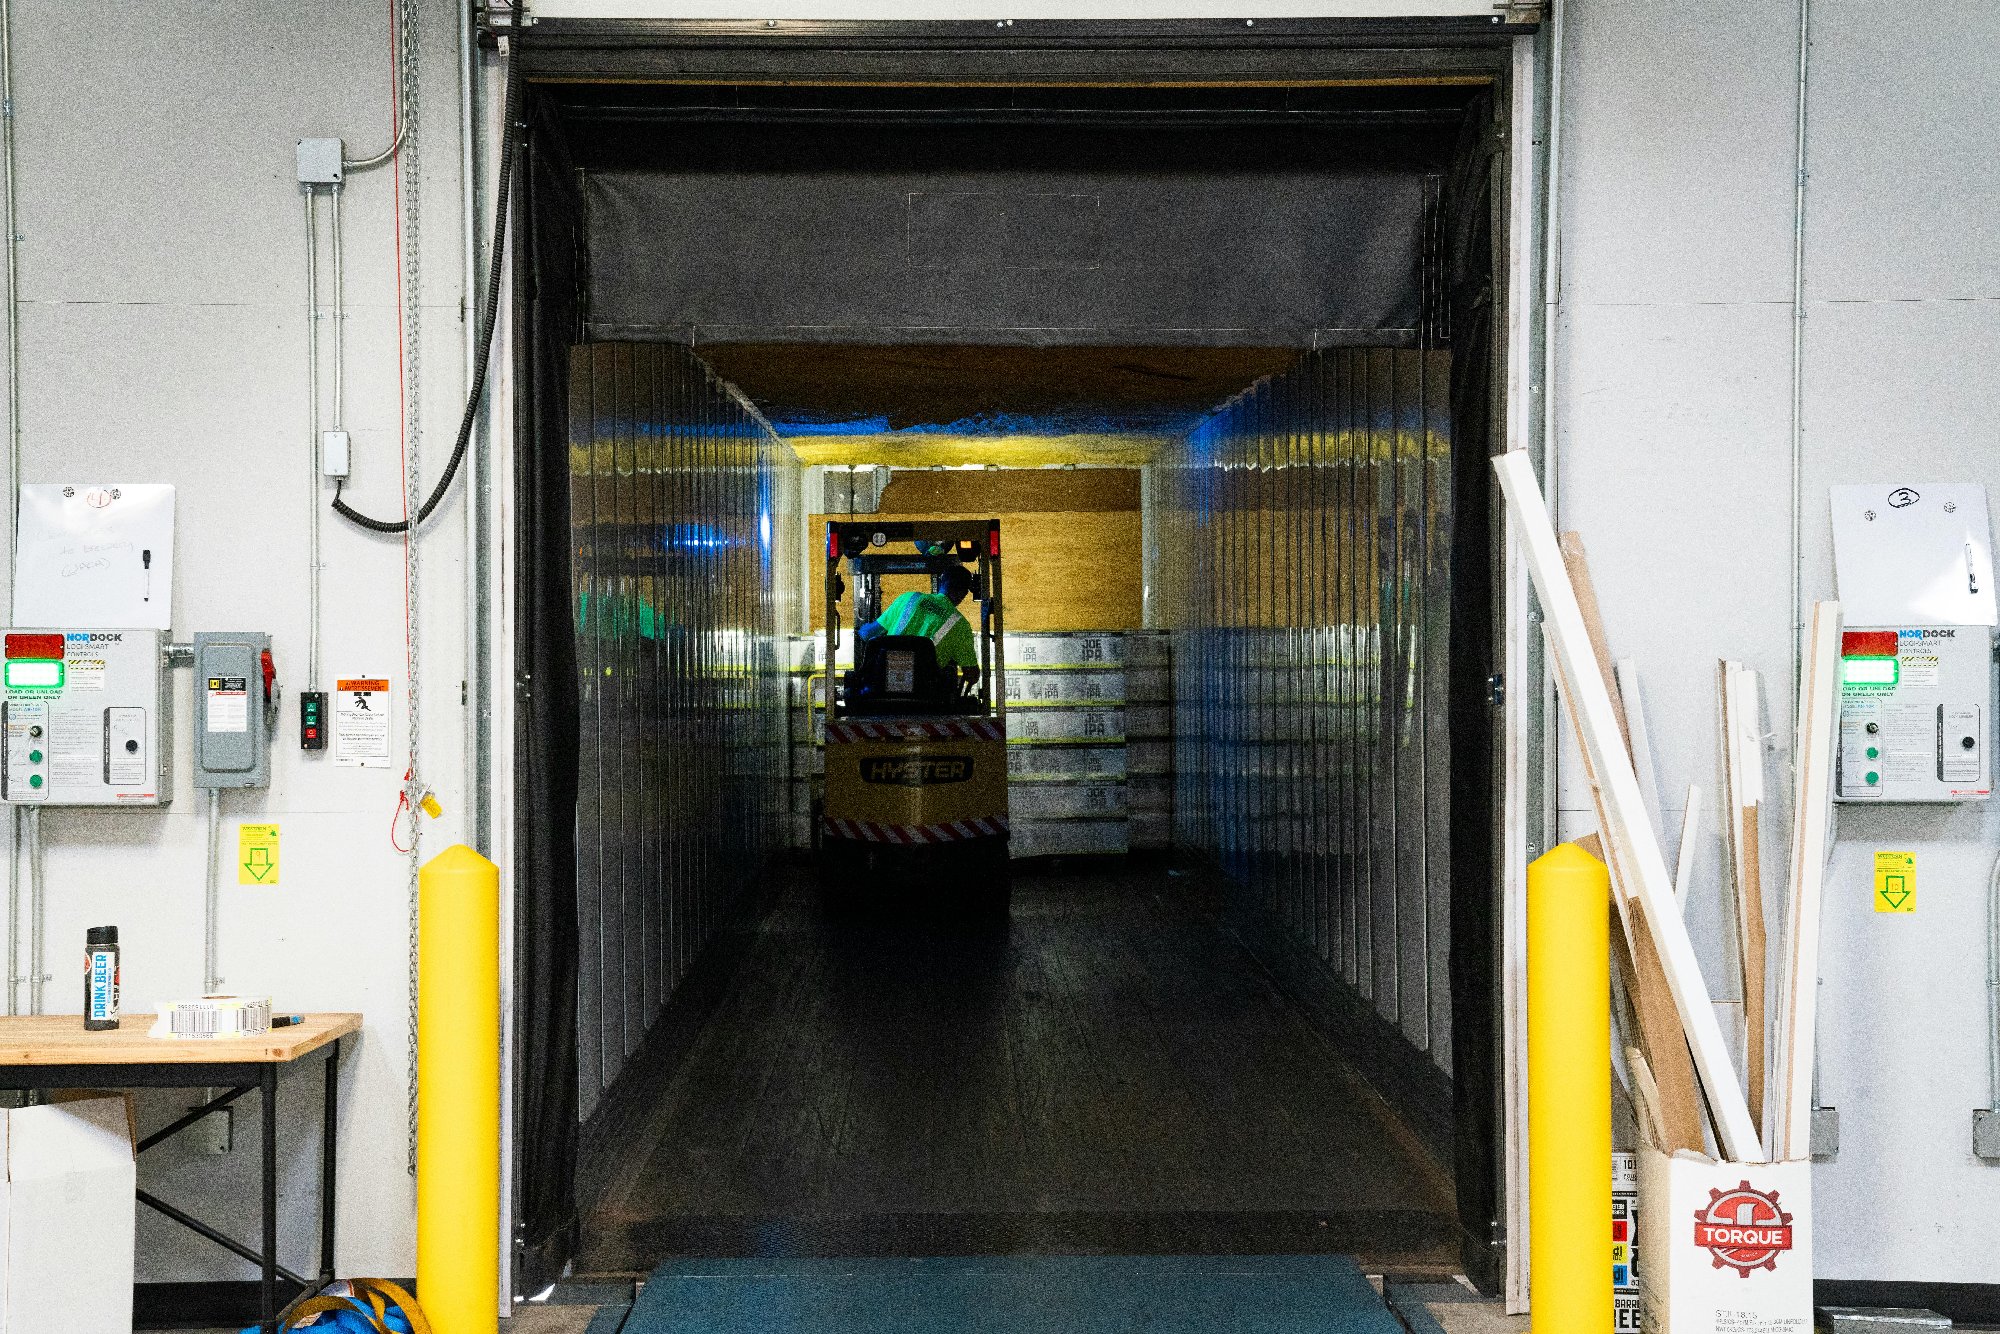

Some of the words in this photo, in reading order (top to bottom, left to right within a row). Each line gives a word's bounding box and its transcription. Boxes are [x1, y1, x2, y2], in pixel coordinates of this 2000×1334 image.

[1898, 491, 1912, 505] 3
[66, 633, 123, 643] NORDOCK
[1899, 629, 1956, 640] NORDOCK
[1082, 639, 1101, 649] JOE
[1082, 650, 1102, 661] IPA
[1005, 688, 1021, 700] PA
[1085, 713, 1105, 723] JOE
[1084, 724, 1105, 736] IPA
[870, 760, 966, 781] HYSTER
[95, 954, 107, 984] BEER
[94, 984, 106, 1018] DRINK
[1703, 1227, 1783, 1245] TORQUE
[1614, 1299, 1640, 1308] BARR
[1614, 1308, 1641, 1328] EE
